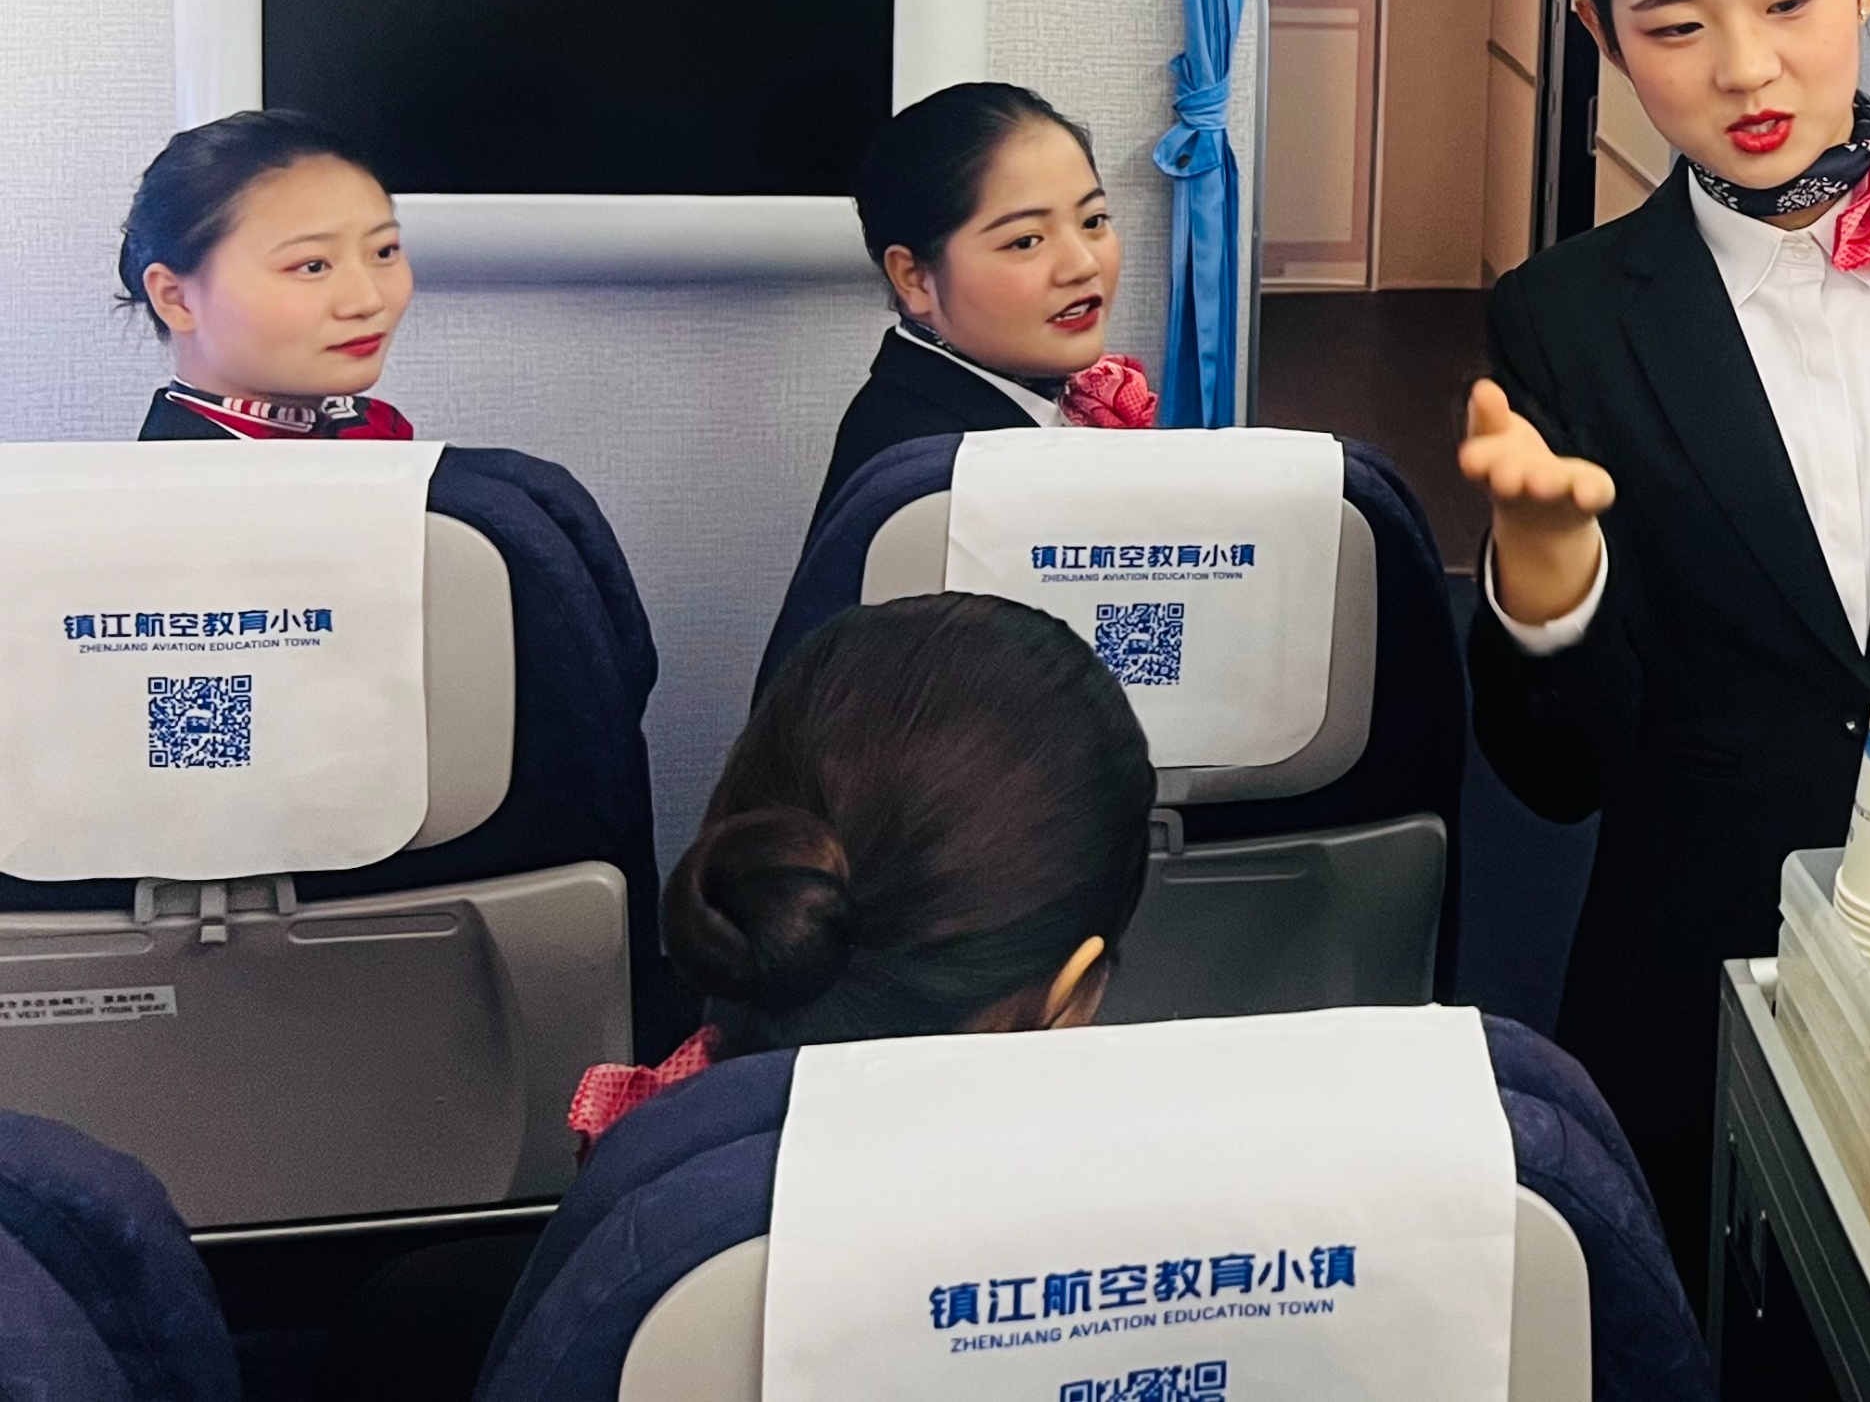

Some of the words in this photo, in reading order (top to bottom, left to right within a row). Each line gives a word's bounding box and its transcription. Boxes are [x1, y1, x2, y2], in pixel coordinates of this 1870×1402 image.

[1031, 543, 1256, 570] 镇江航空教育小镇
[1041, 572, 1100, 583] ZHENJIANG
[1102, 572, 1150, 582] AVIATION
[1152, 571, 1210, 581] EDUCATION
[1213, 571, 1243, 580] TOWN
[63, 607, 334, 641] 镇江航空教育小镇
[79, 642, 149, 654] ZHENJIANG
[151, 641, 206, 652] AVIATION
[209, 639, 281, 651] EDUCATION
[284, 637, 322, 648] TOWN
[929, 1244, 1357, 1329] 镇江航空教育小镇
[949, 1327, 1063, 1354] ZHENJIANG
[1068, 1313, 1158, 1340] AVIATION
[1162, 1301, 1271, 1326] EDUCATION
[1277, 1298, 1336, 1316] TOWN
